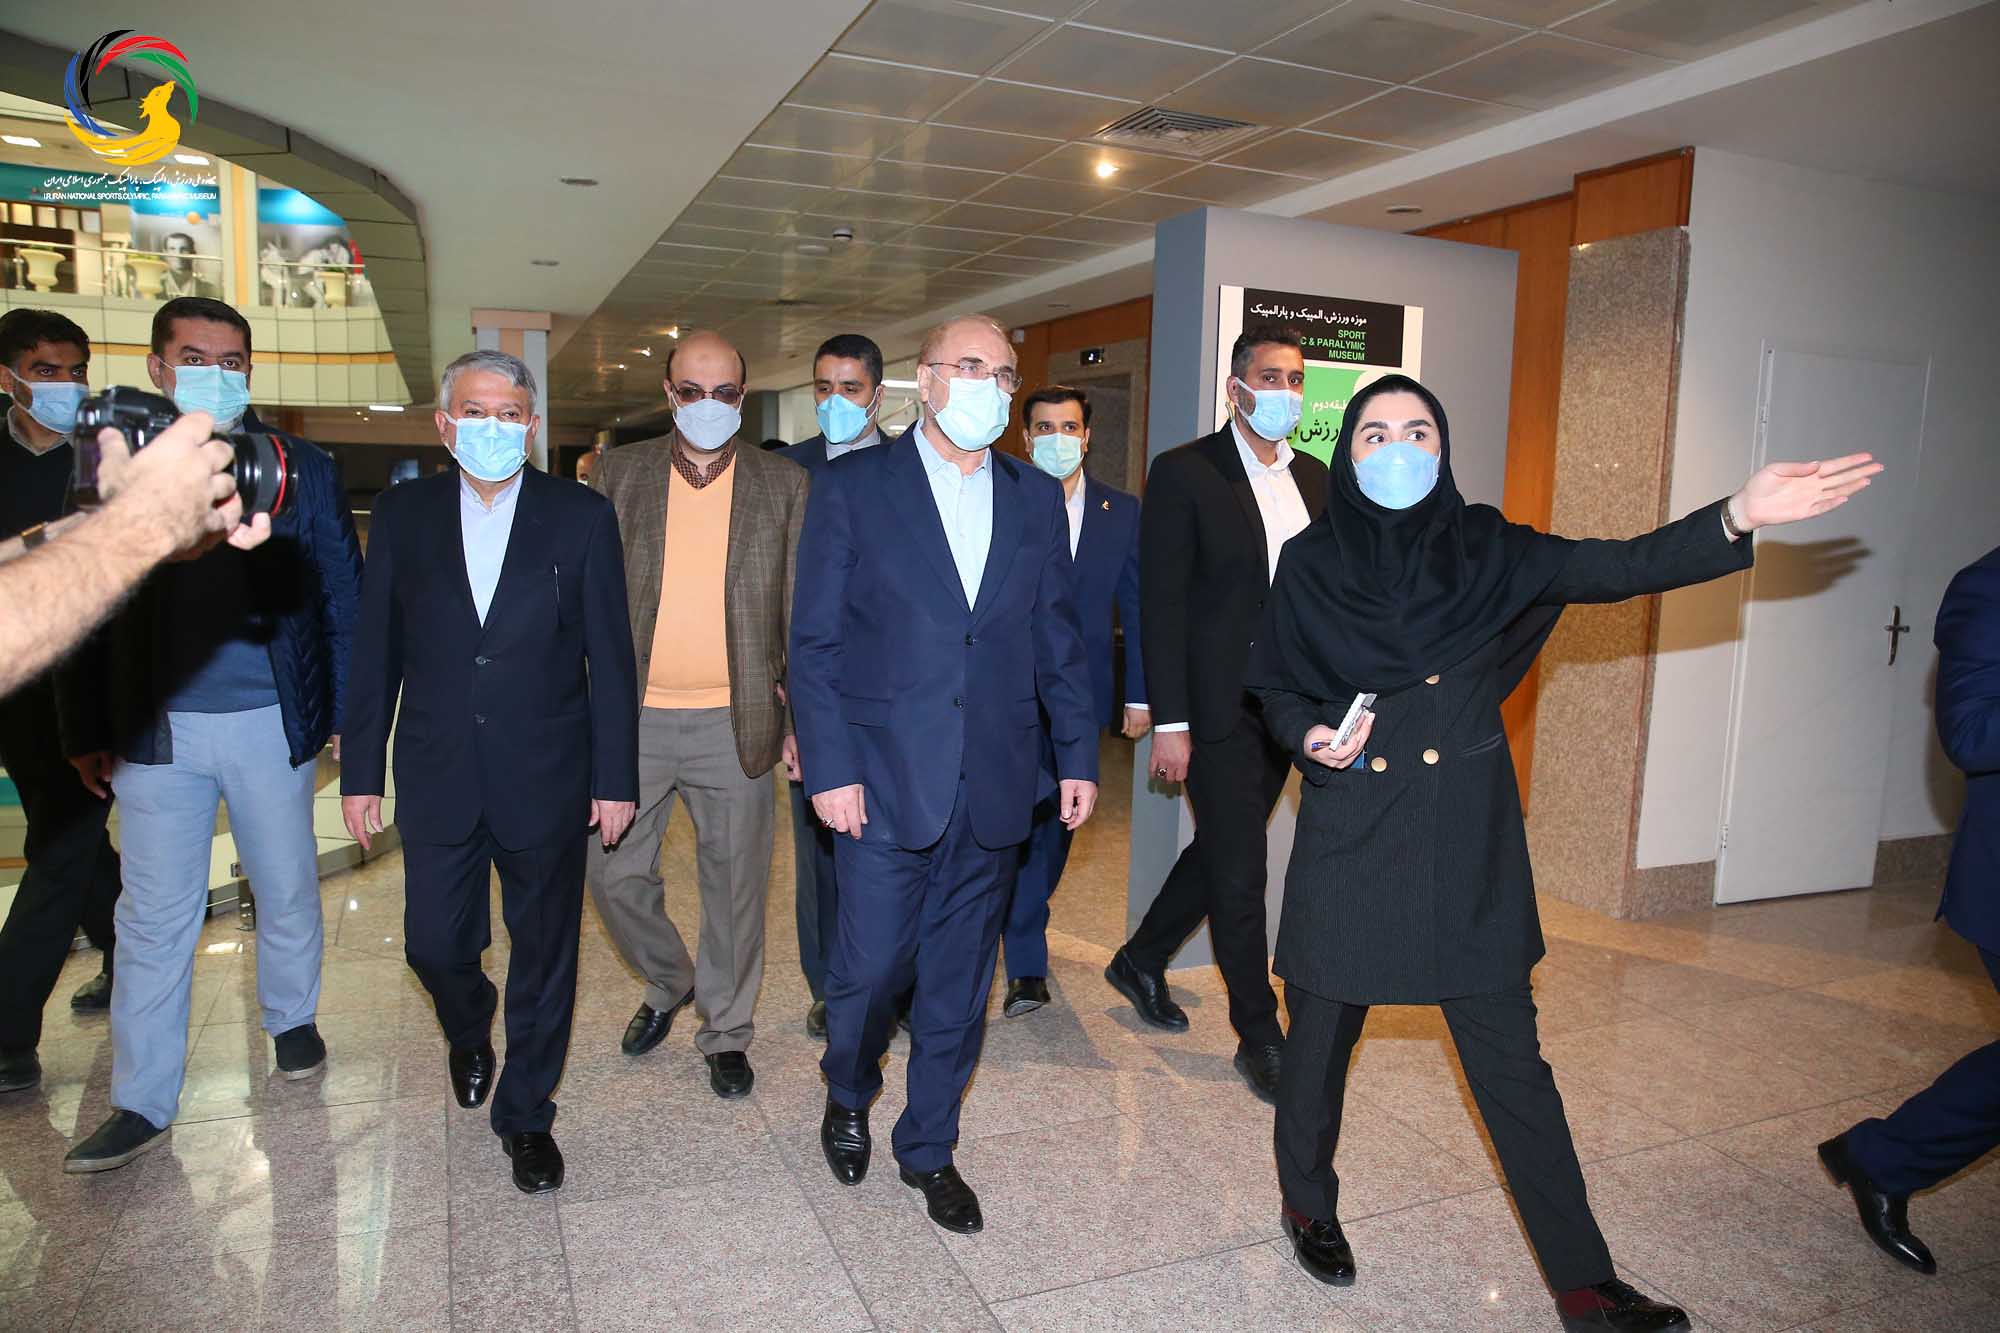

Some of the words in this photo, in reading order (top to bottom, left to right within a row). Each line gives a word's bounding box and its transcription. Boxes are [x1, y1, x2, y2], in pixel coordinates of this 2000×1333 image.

[1250, 303, 1289, 320] پارالمپیک
[1289, 310, 1295, 320] و
[1296, 307, 1323, 322] المپیک
[1350, 314, 1367, 327] موزه
[1337, 329, 1367, 340] SPORT
[1308, 336, 1316, 346] &
[1328, 349, 1365, 361] MUSEUM
[1300, 418, 1339, 443] رزش
